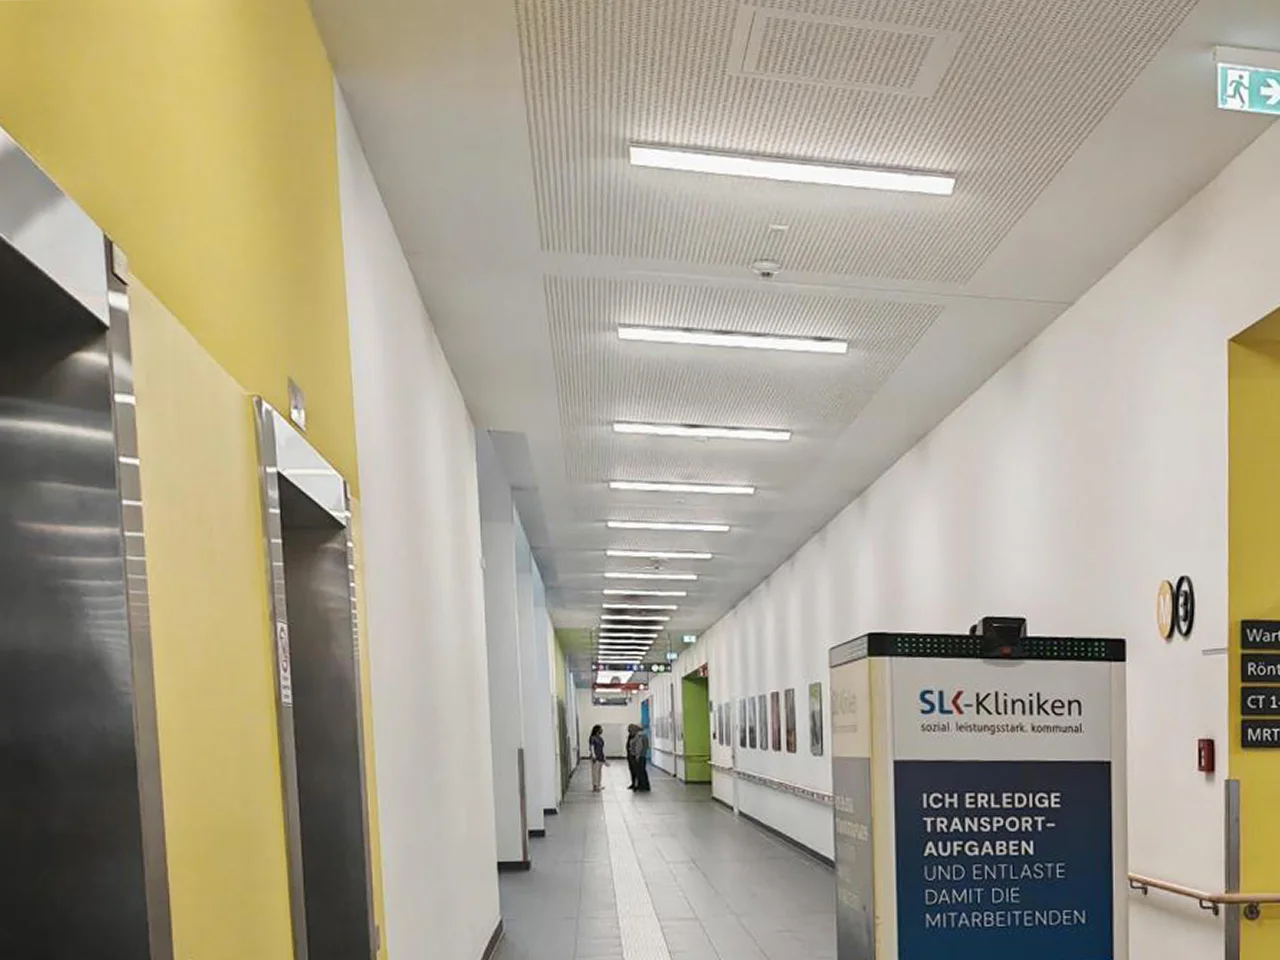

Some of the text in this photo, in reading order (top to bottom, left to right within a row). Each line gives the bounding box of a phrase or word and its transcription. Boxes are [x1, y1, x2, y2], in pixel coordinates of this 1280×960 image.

[919, 690, 1083, 716] SLK-Kliniken
[1247, 695, 1265, 709] CT
[1247, 728, 1280, 741] MRT
[922, 792, 1062, 809] ICH ERLEDIGE
[923, 816, 1056, 833] TRANSPORT-
[923, 840, 1034, 857] AUFGABEN
[924, 863, 1066, 881] UND ENTLASTE
[925, 887, 1021, 905] DAMIT DIE
[925, 910, 1087, 929] MITARBEITENDEN
